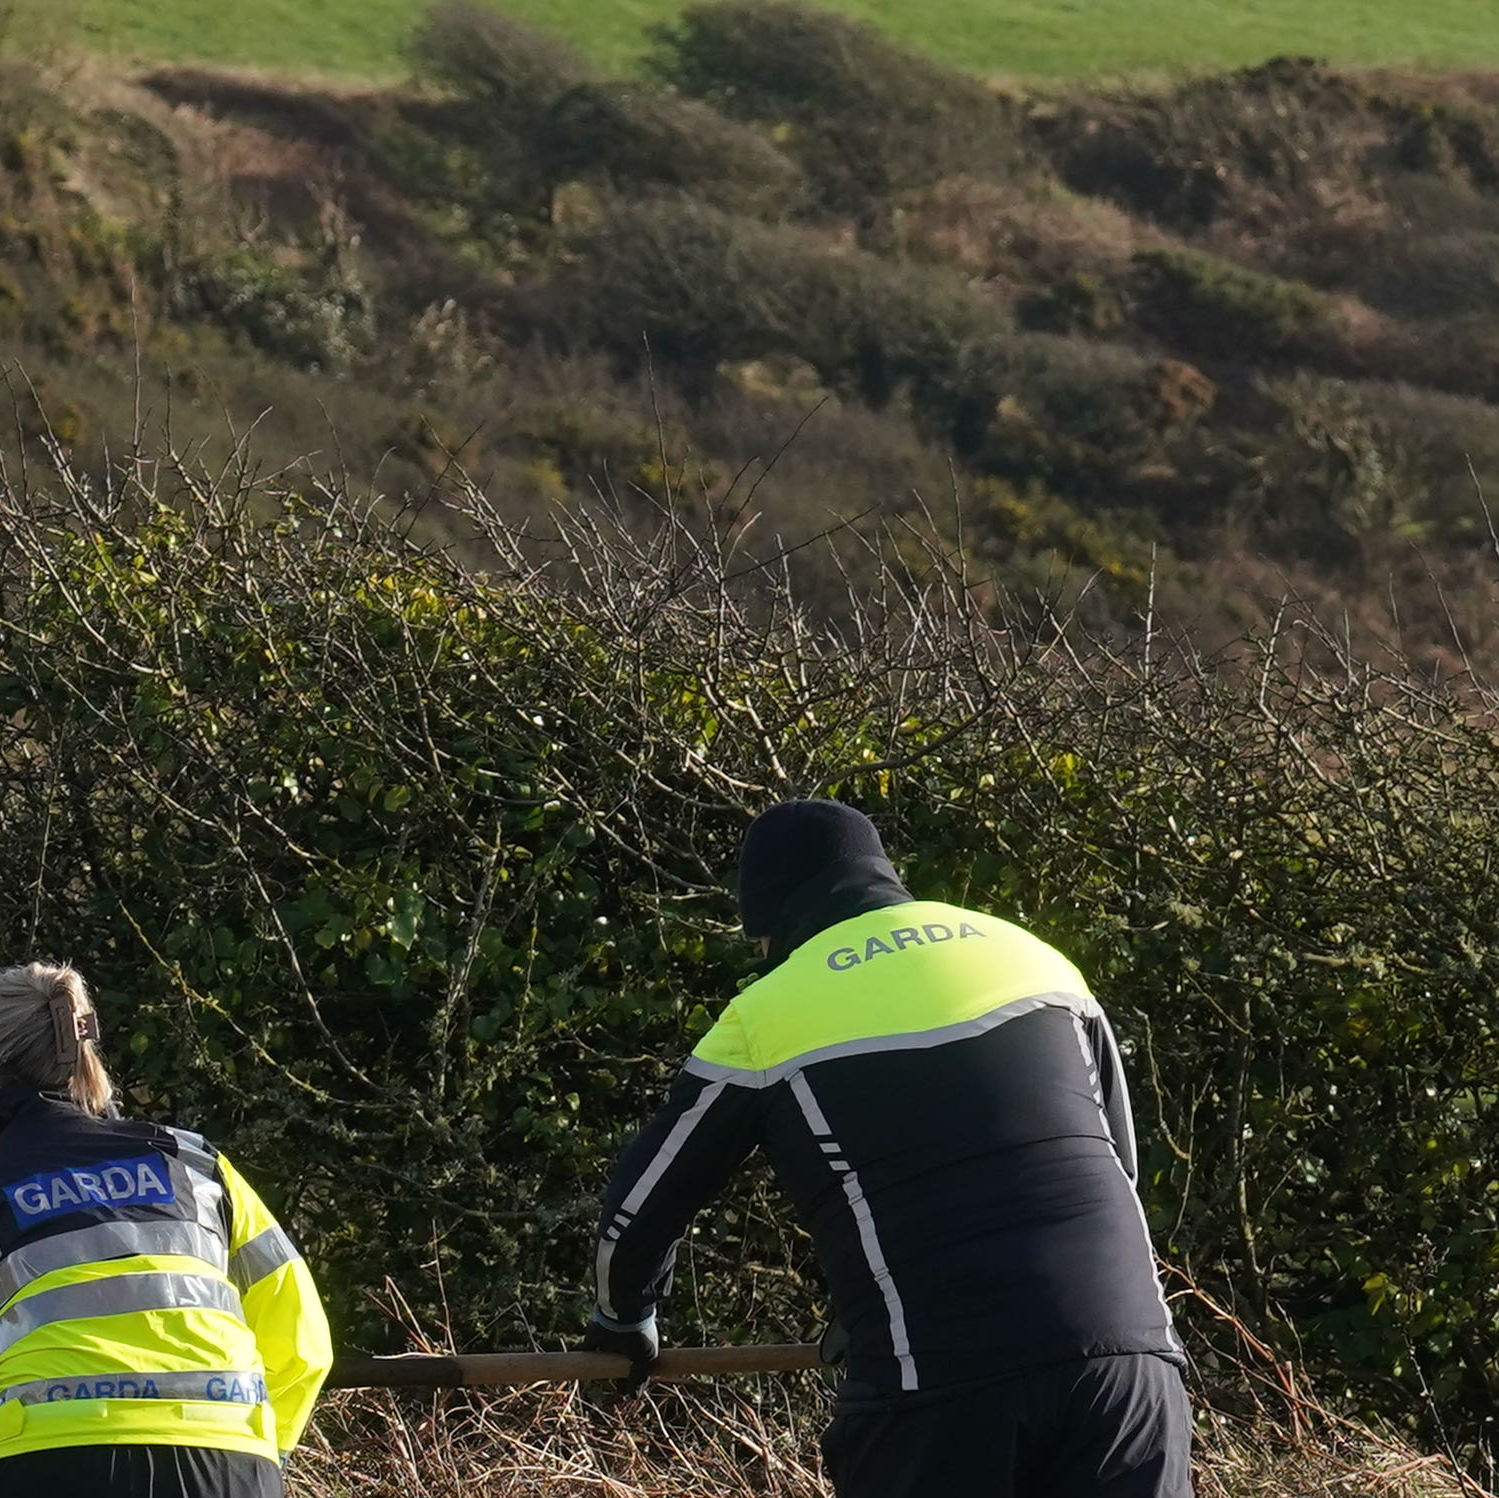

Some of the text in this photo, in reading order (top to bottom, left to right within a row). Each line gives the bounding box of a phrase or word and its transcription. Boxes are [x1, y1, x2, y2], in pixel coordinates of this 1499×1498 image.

[827, 922, 987, 971] GARDA
[13, 1162, 169, 1216] GARDA
[47, 1379, 161, 1401] GARDA
